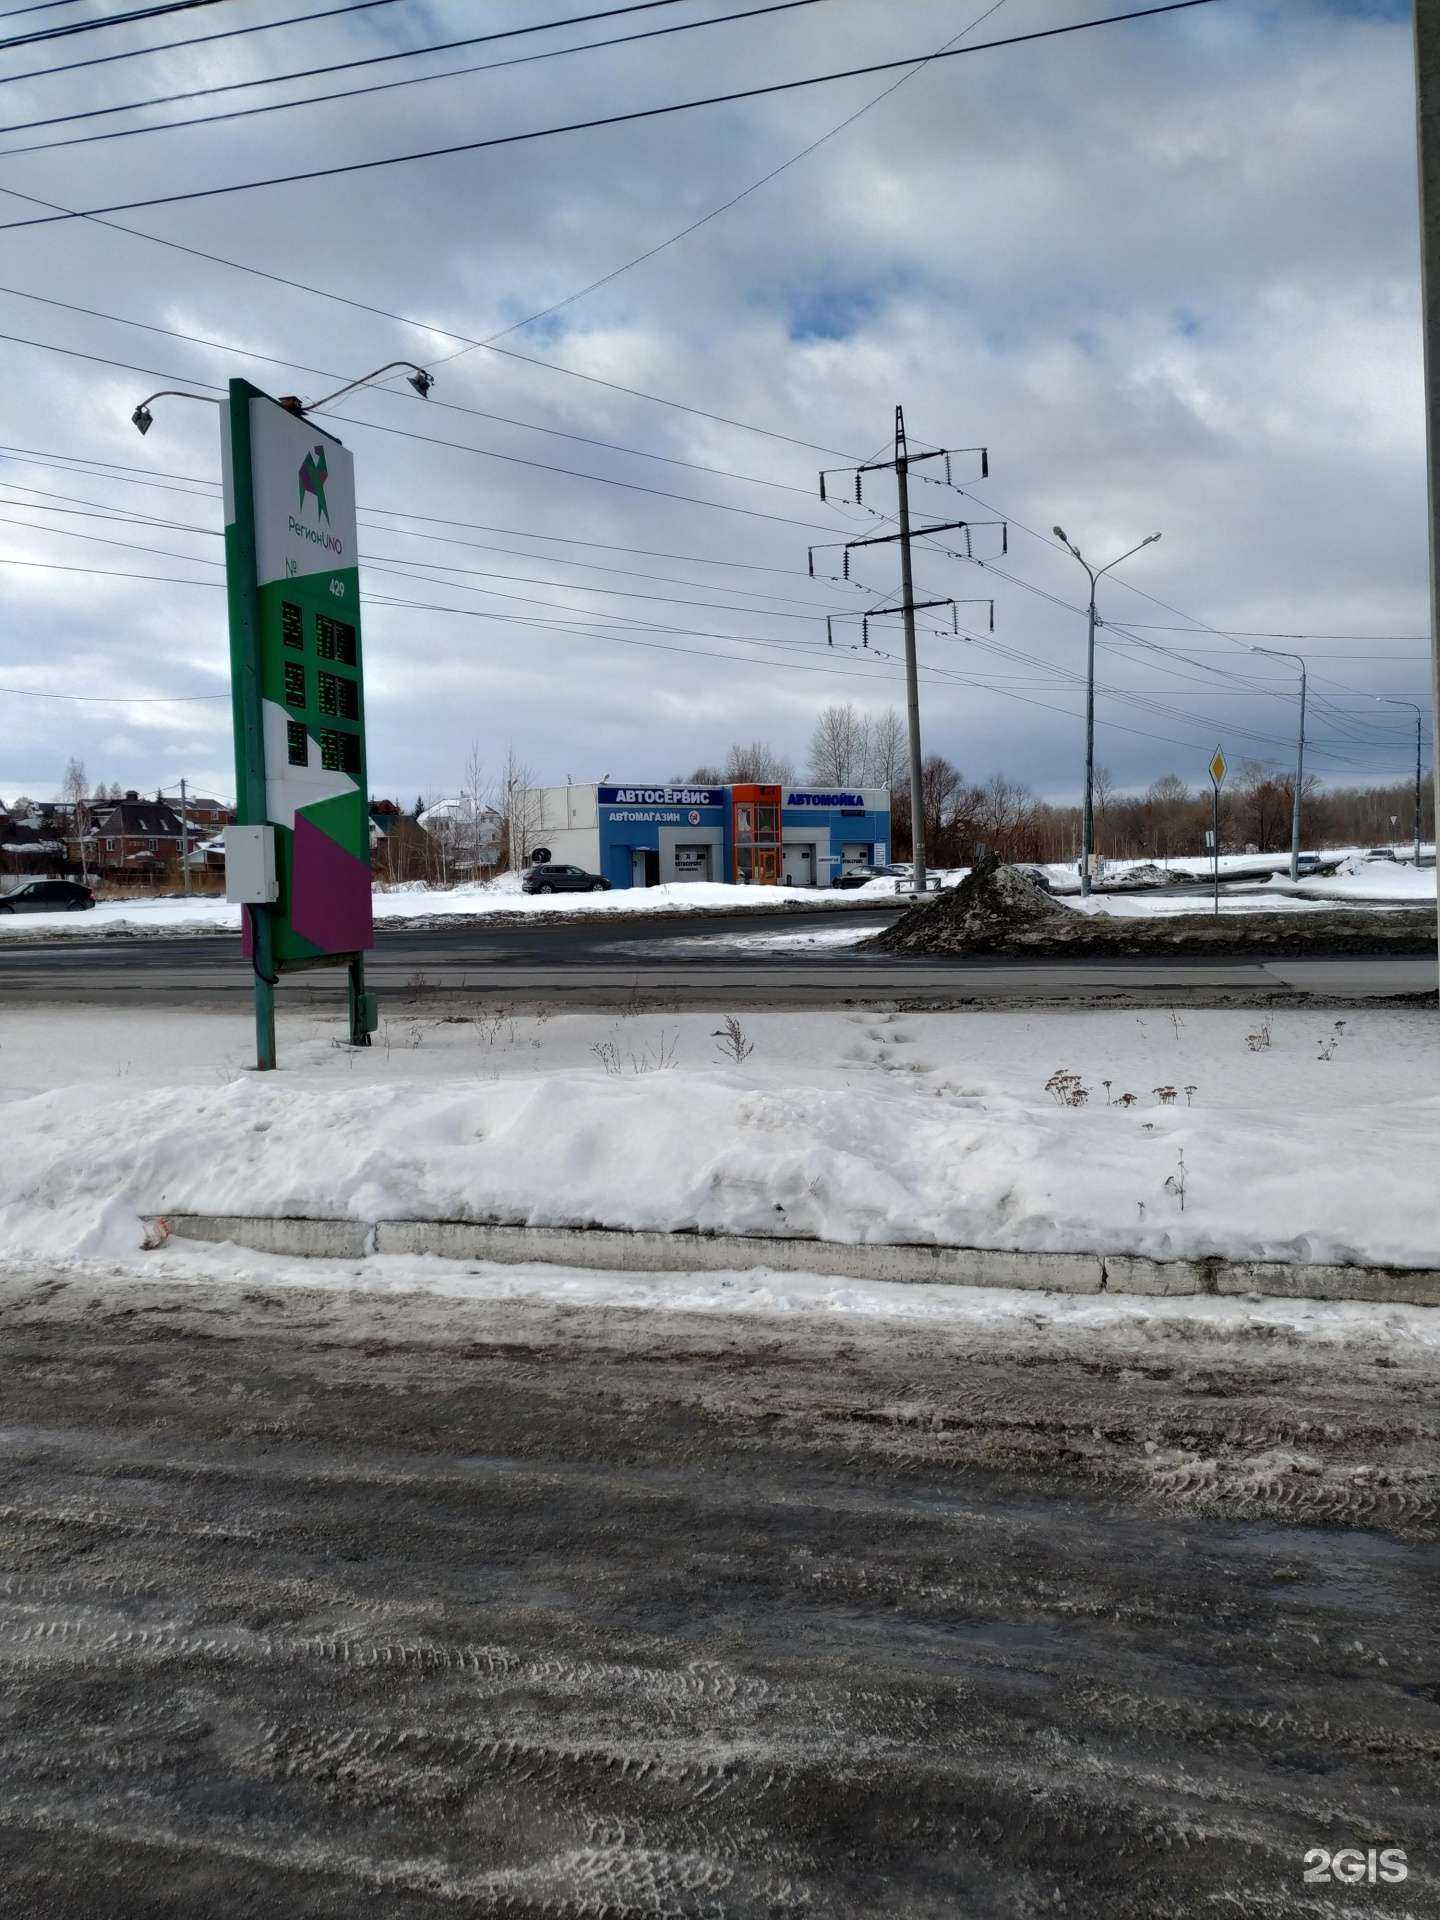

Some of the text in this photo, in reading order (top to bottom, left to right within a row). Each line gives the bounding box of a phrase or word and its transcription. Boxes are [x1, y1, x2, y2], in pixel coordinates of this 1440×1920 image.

[329, 578, 345, 598] 429
[615, 789, 711, 804] АВТОСЕРВИС
[787, 792, 865, 807] АВТОМОЙКА
[608, 812, 681, 822] АВТОМАГАЗИН
